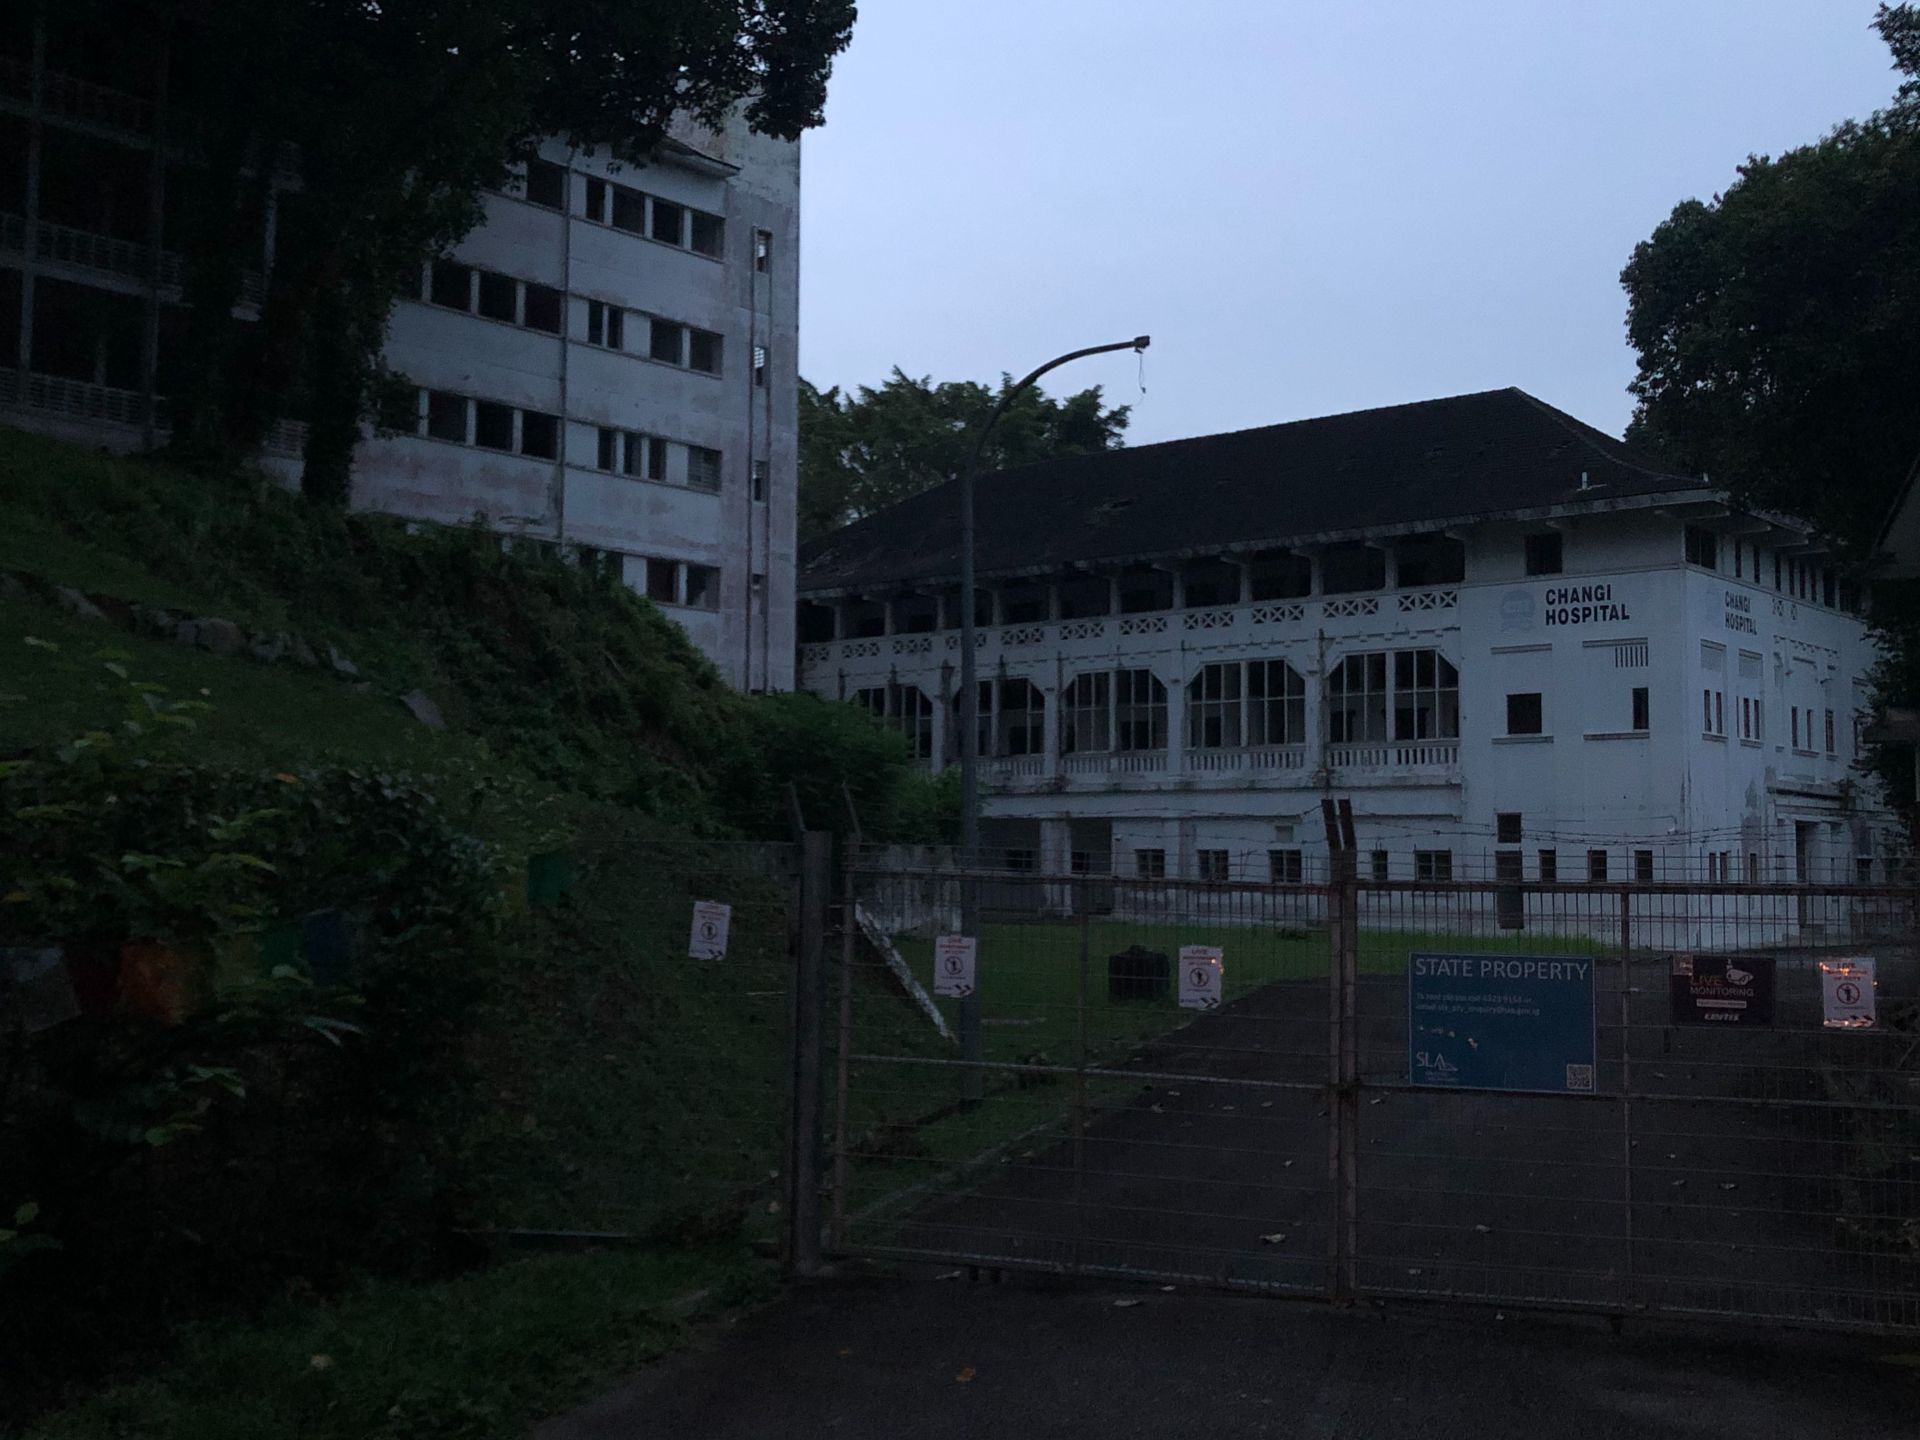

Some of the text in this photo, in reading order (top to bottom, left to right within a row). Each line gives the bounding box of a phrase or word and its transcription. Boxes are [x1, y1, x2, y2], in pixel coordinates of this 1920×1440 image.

[1545, 584, 1611, 606] CHANGI
[1724, 591, 1751, 613] CHANGI
[1545, 604, 1630, 626] HOSPITAL
[1724, 613, 1757, 635] HOSPITAL
[1415, 958, 1588, 981] STATE PROPERTY
[1689, 974, 1723, 986] LIVE
[1689, 986, 1754, 997] MONITORING
[1415, 1051, 1451, 1071] SLA
